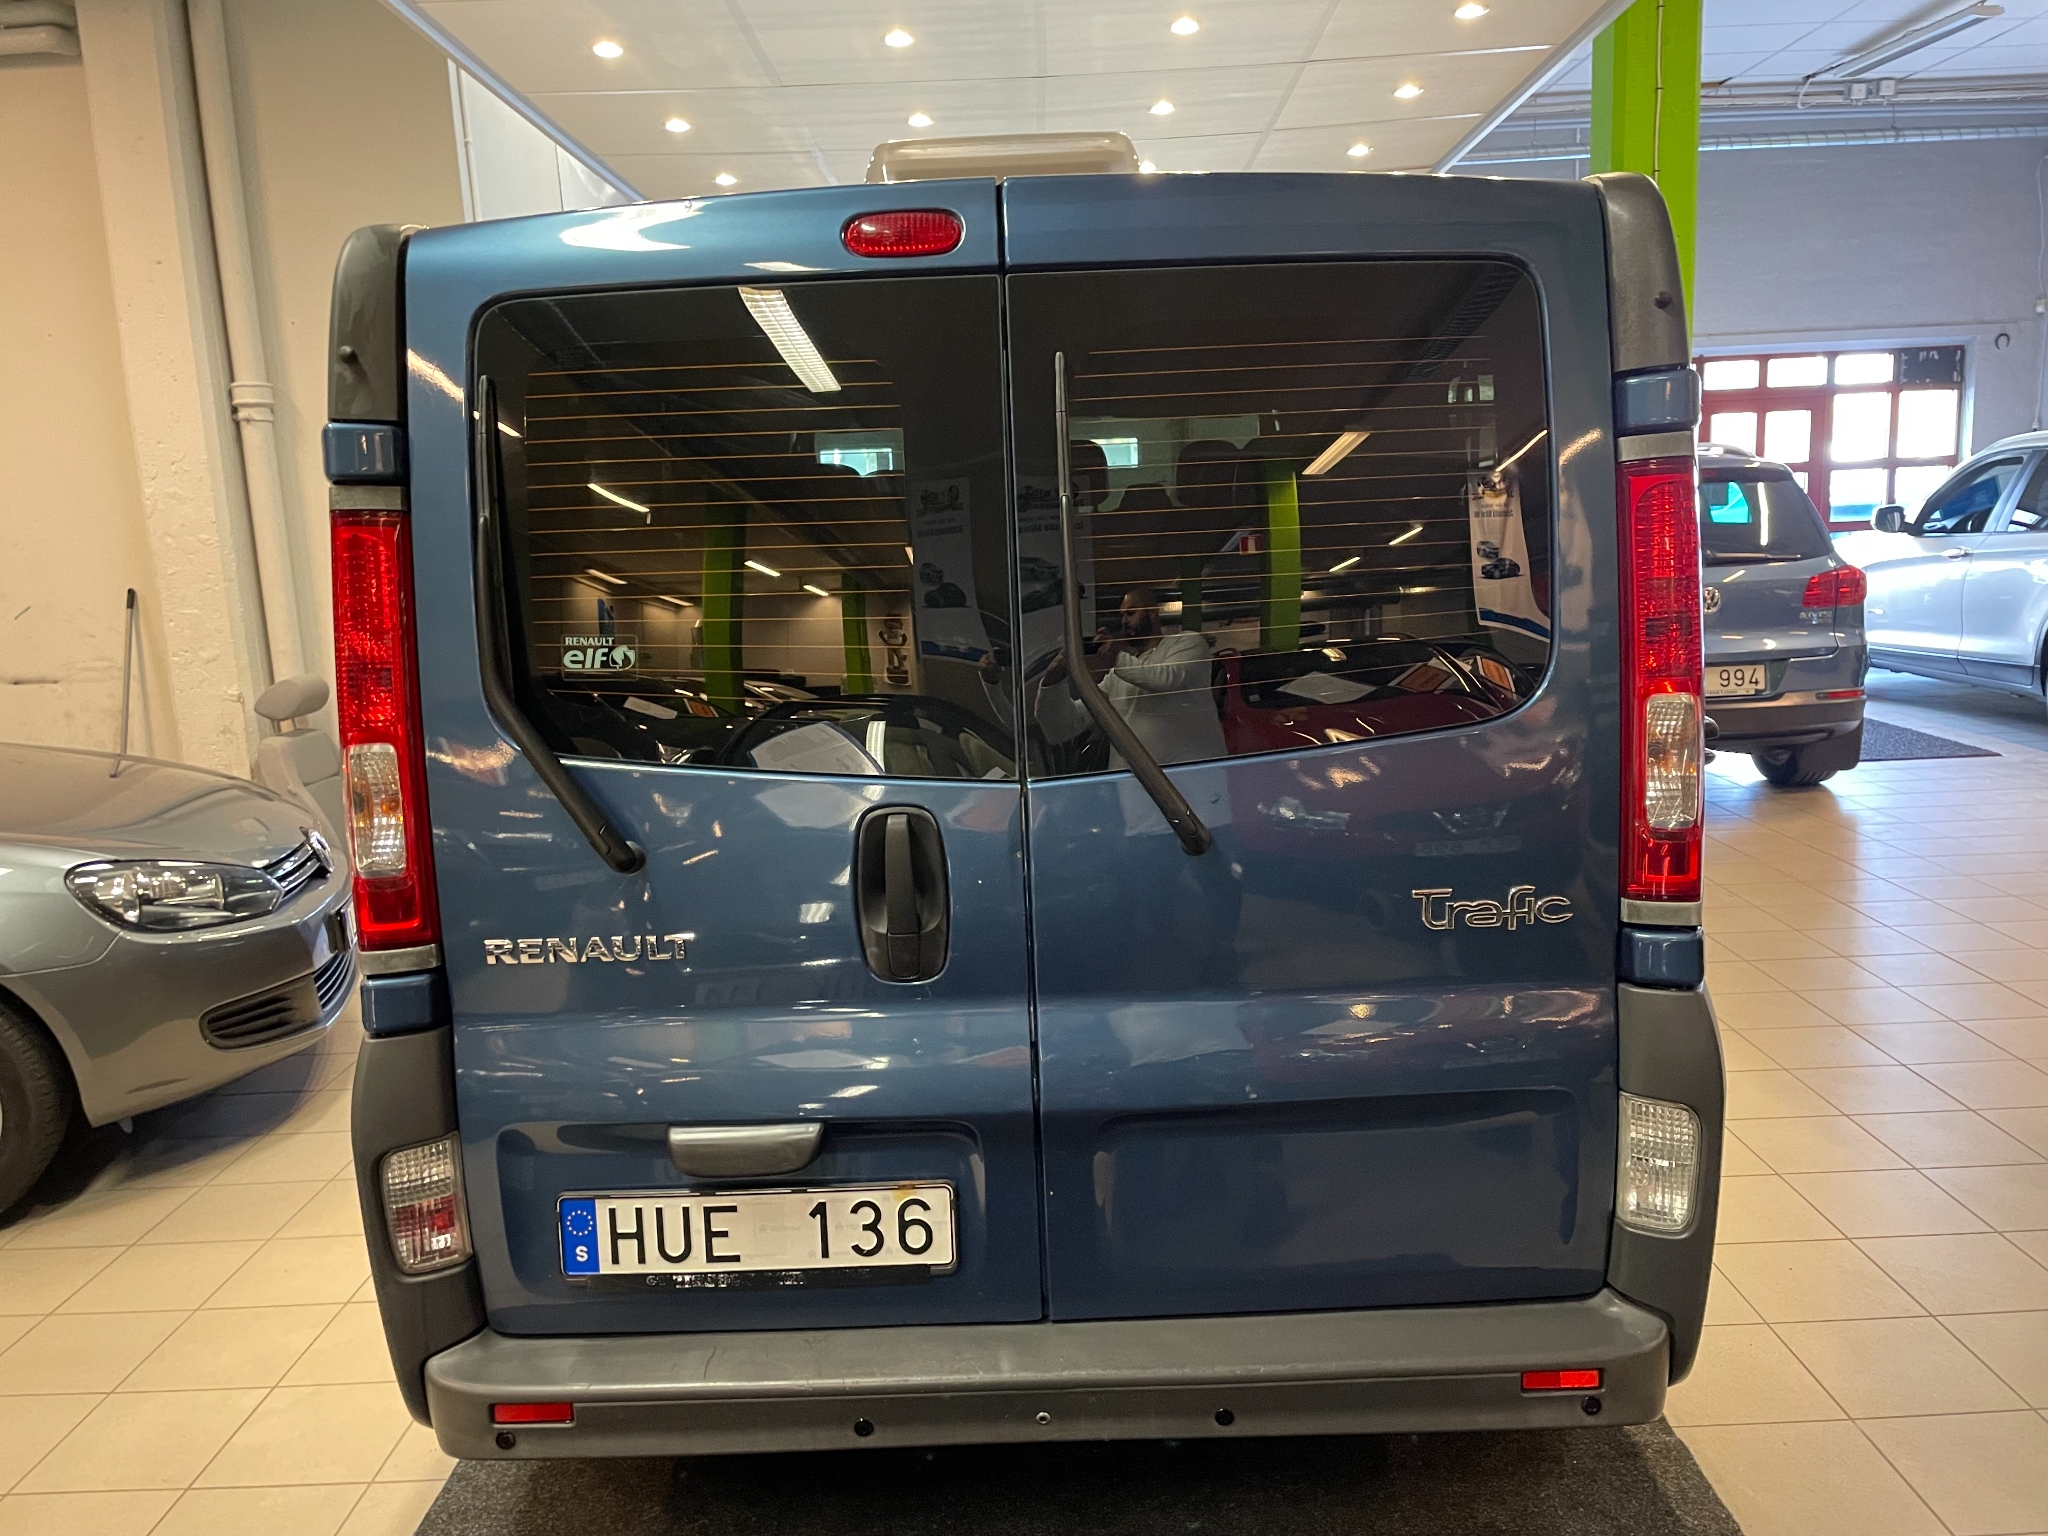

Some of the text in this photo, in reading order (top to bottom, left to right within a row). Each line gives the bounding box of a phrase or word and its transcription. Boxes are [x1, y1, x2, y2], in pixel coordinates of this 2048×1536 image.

[565, 636, 615, 646] RENAULT
[563, 648, 609, 669] elf
[1719, 667, 1760, 688] 994
[1411, 885, 1574, 931] Trafic
[484, 933, 697, 965] RENAULT
[608, 1198, 934, 1265] HUE 136
[575, 1246, 589, 1262] S
